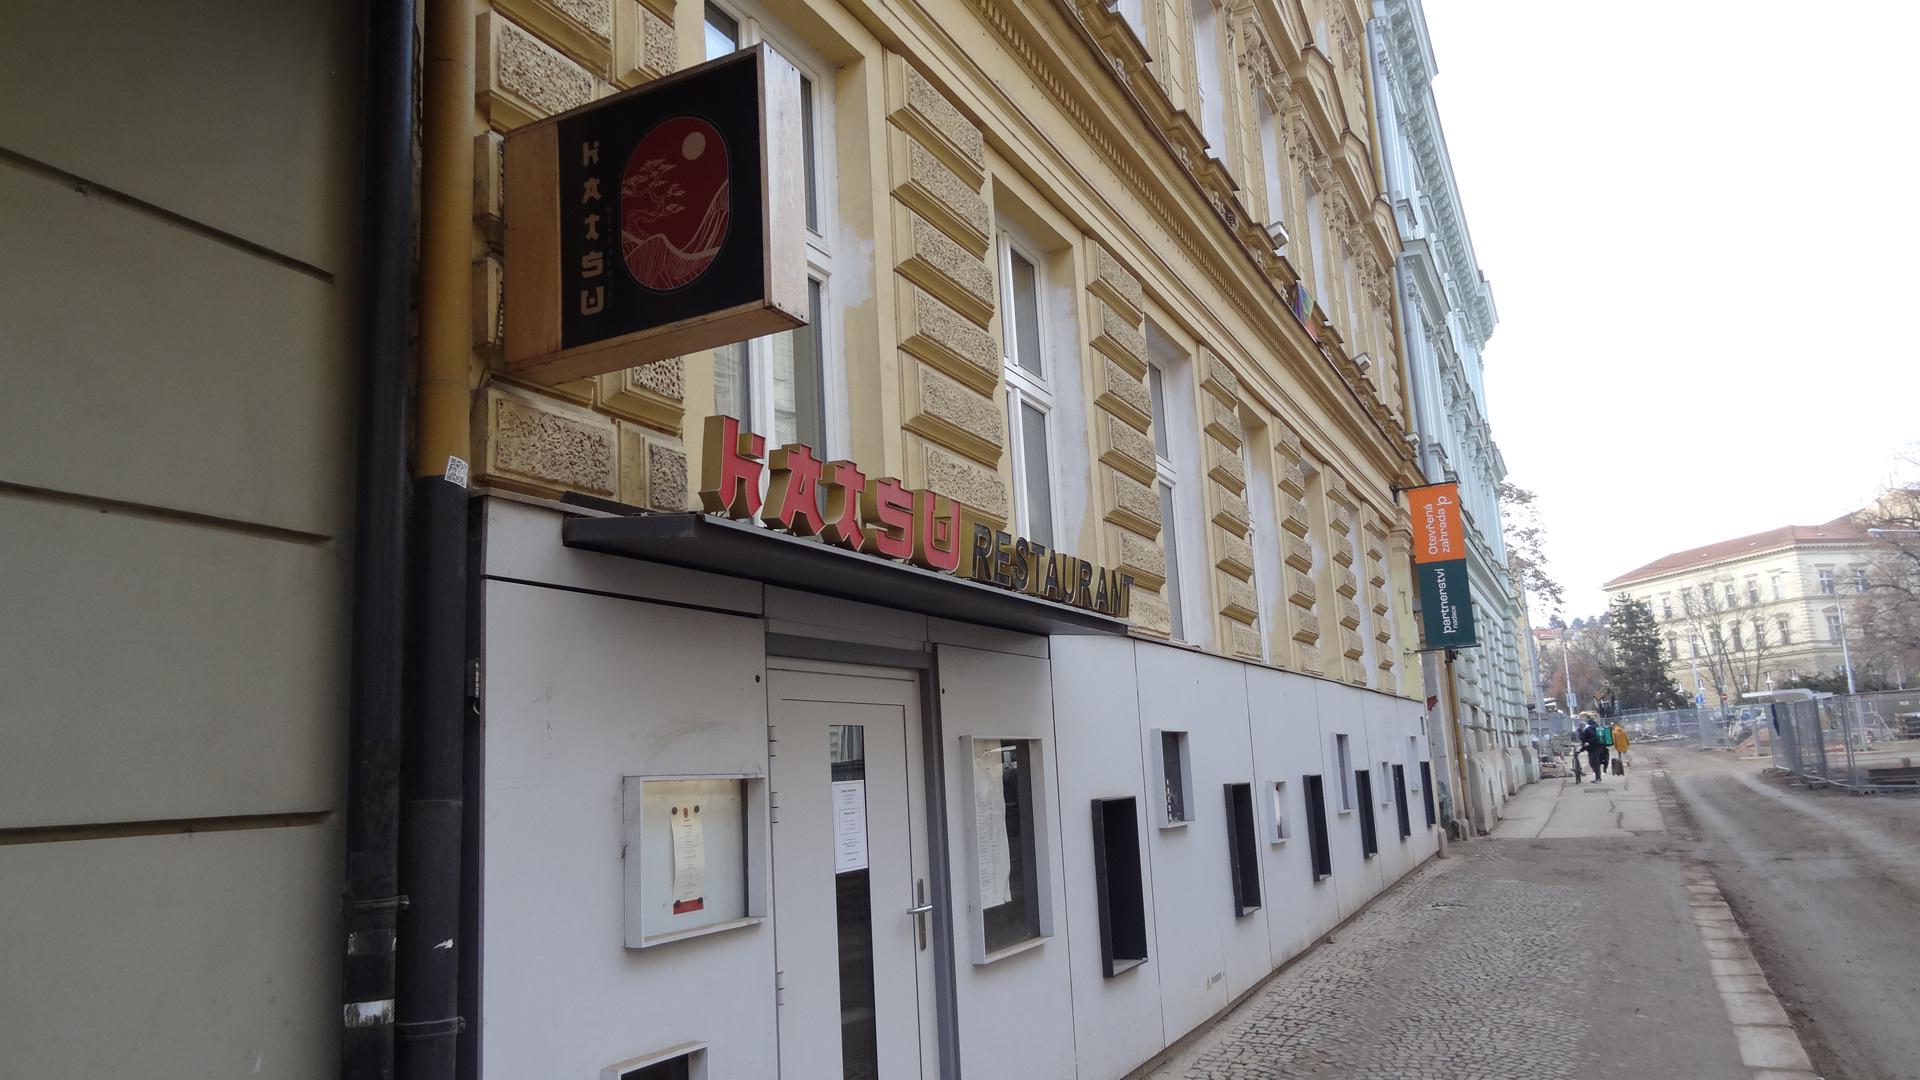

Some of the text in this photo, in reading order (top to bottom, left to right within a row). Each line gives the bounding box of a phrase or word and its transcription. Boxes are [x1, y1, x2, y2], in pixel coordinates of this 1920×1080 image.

[580, 141, 604, 316] KATSU
[700, 415, 1135, 618] KATSU RESTAURANT
[1423, 503, 1438, 555] Otevřená
[1437, 508, 1450, 553] zahrada
[1434, 568, 1456, 634] partnerství
[1450, 605, 1459, 629] nadace
